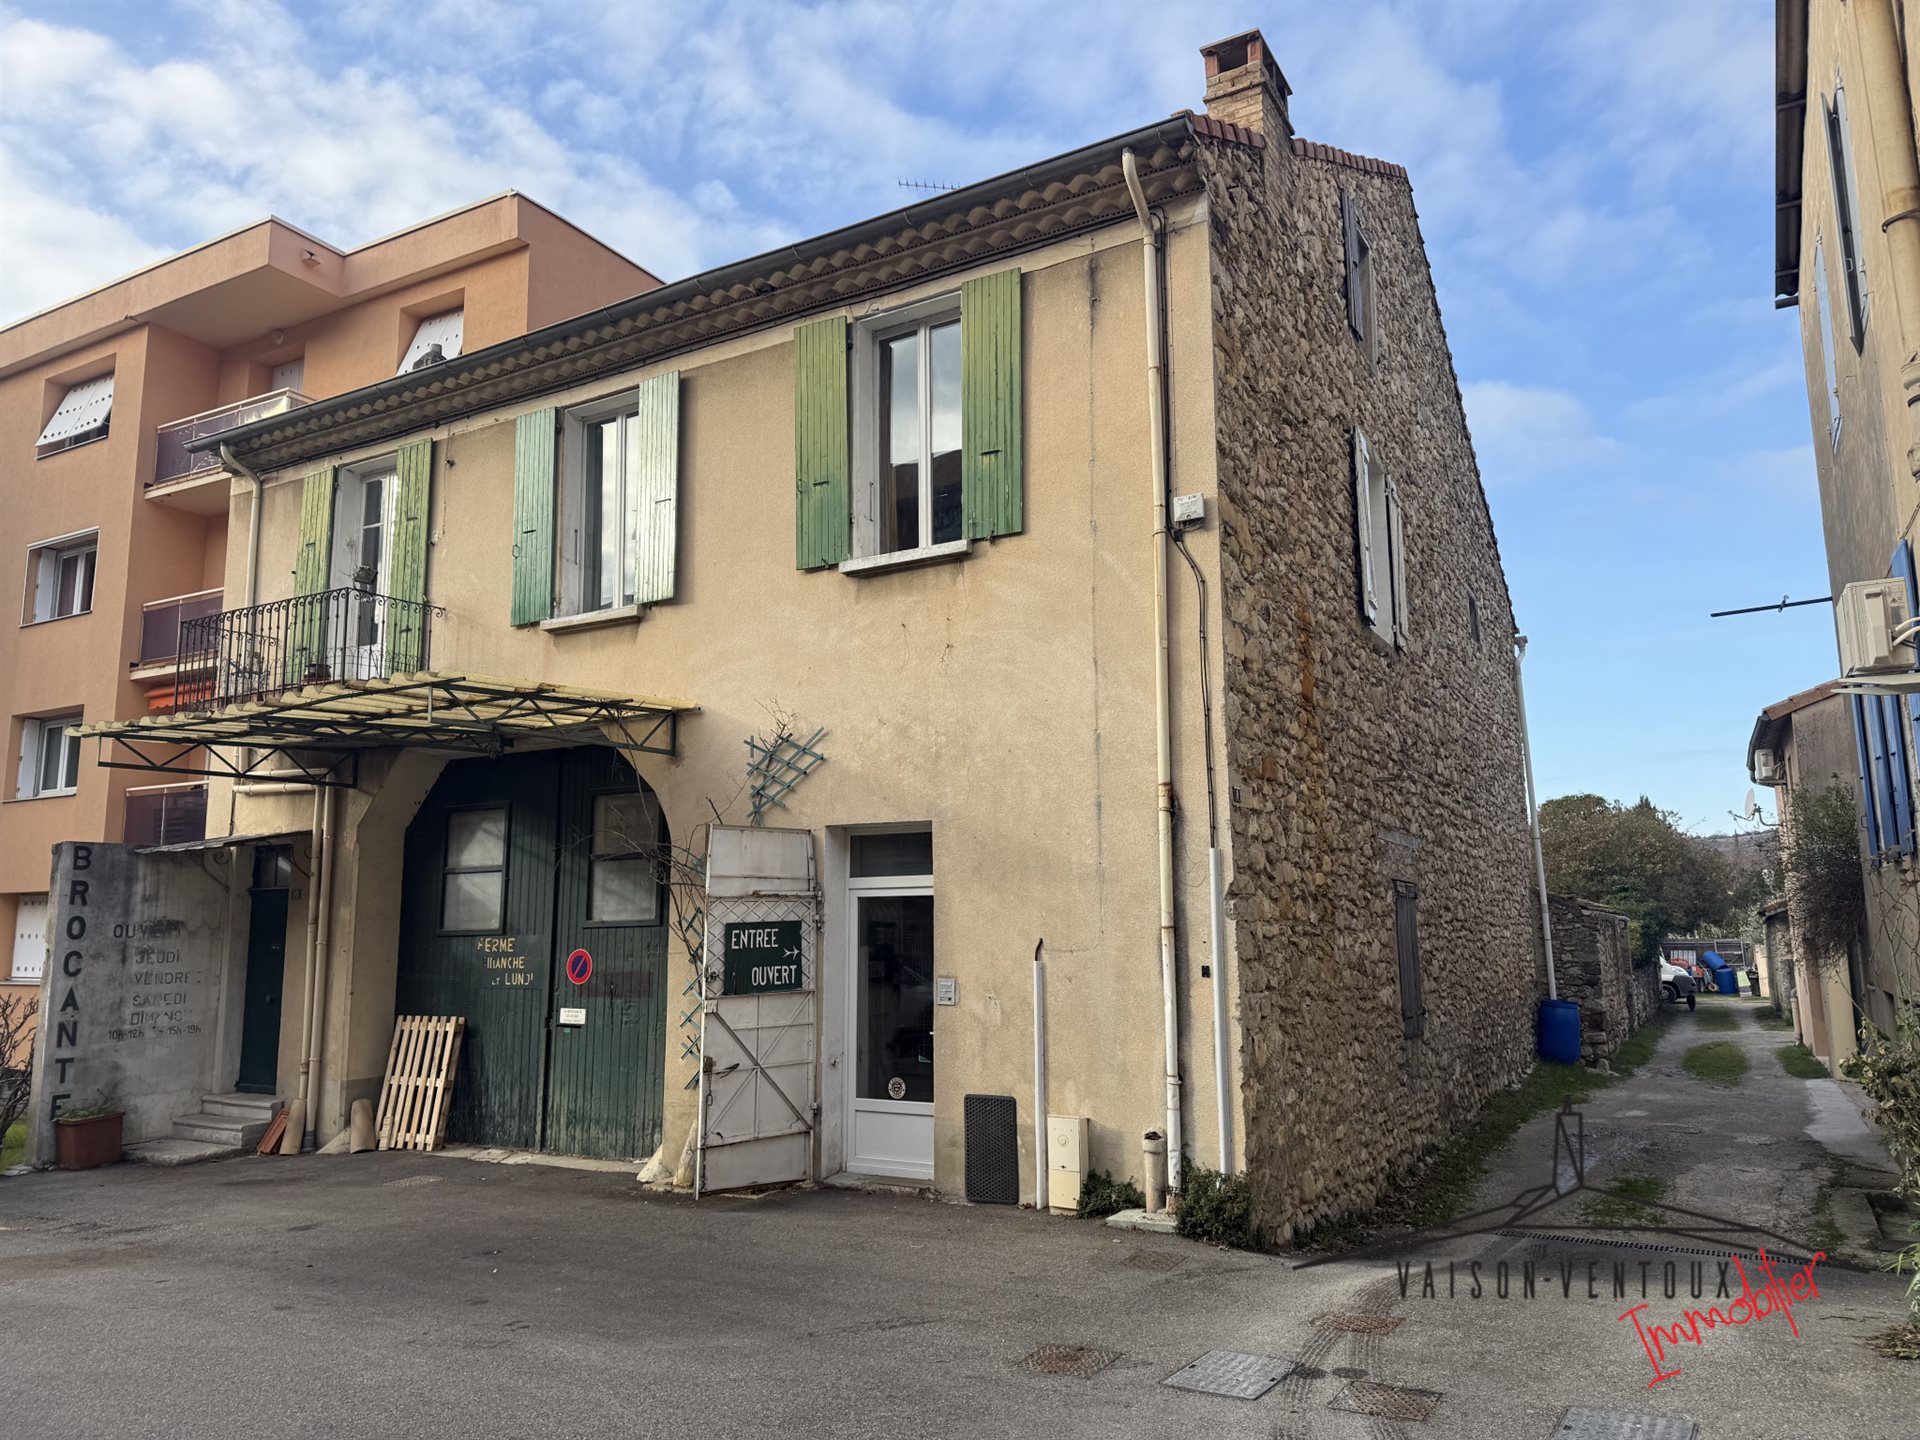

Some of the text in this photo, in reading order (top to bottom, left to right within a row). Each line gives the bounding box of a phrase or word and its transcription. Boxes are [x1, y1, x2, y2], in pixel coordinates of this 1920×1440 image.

[477, 937, 516, 953] FERME
[731, 928, 779, 950] ENTREE
[484, 956, 525, 969] IMANCHE
[751, 965, 797, 986] OUVERT
